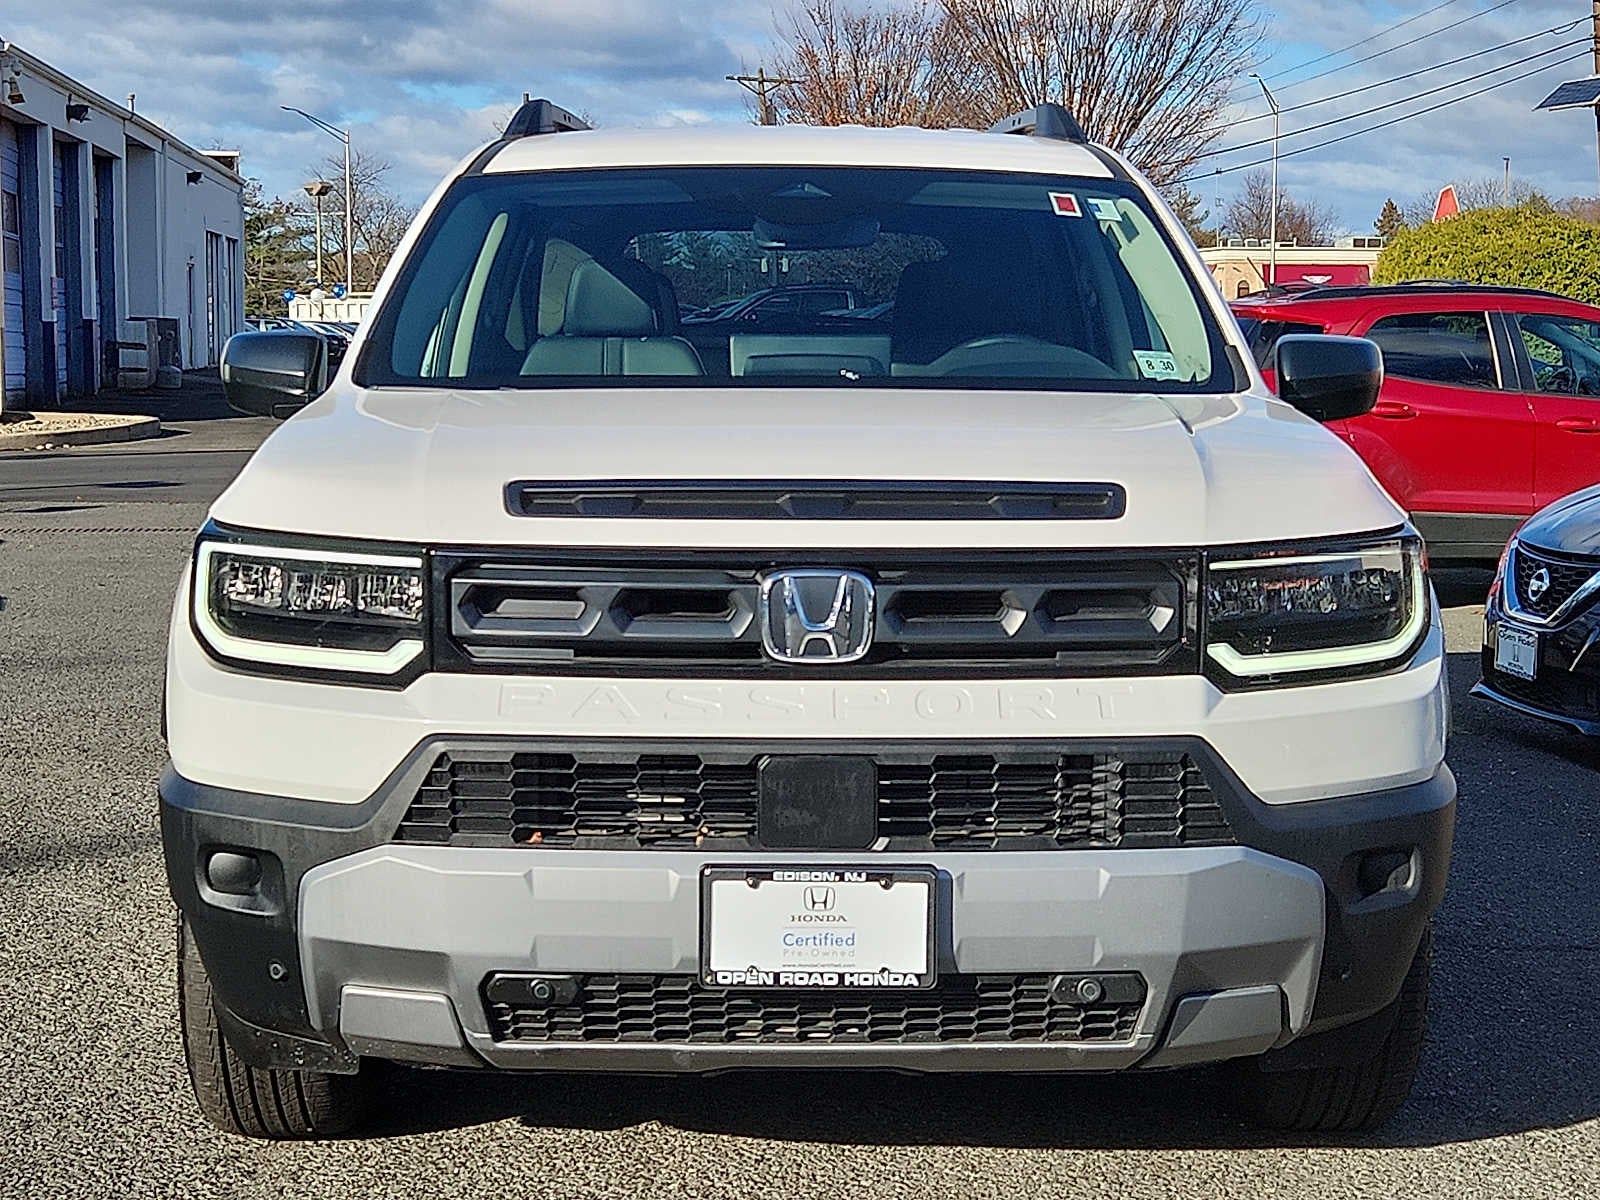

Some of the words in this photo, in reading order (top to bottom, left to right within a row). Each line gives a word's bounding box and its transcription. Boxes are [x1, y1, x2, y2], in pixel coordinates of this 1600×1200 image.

[1146, 360, 1155, 370] 8
[1160, 360, 1174, 371] 30
[496, 684, 1135, 721] PASSPORT
[844, 871, 867, 881] NJ
[791, 914, 847, 922] HONDA
[783, 933, 855, 946] Certified
[783, 948, 855, 958] Pre-Owned
[716, 971, 774, 985] OPEN
[779, 972, 839, 986] ROAD
[844, 972, 919, 987] HONDA
